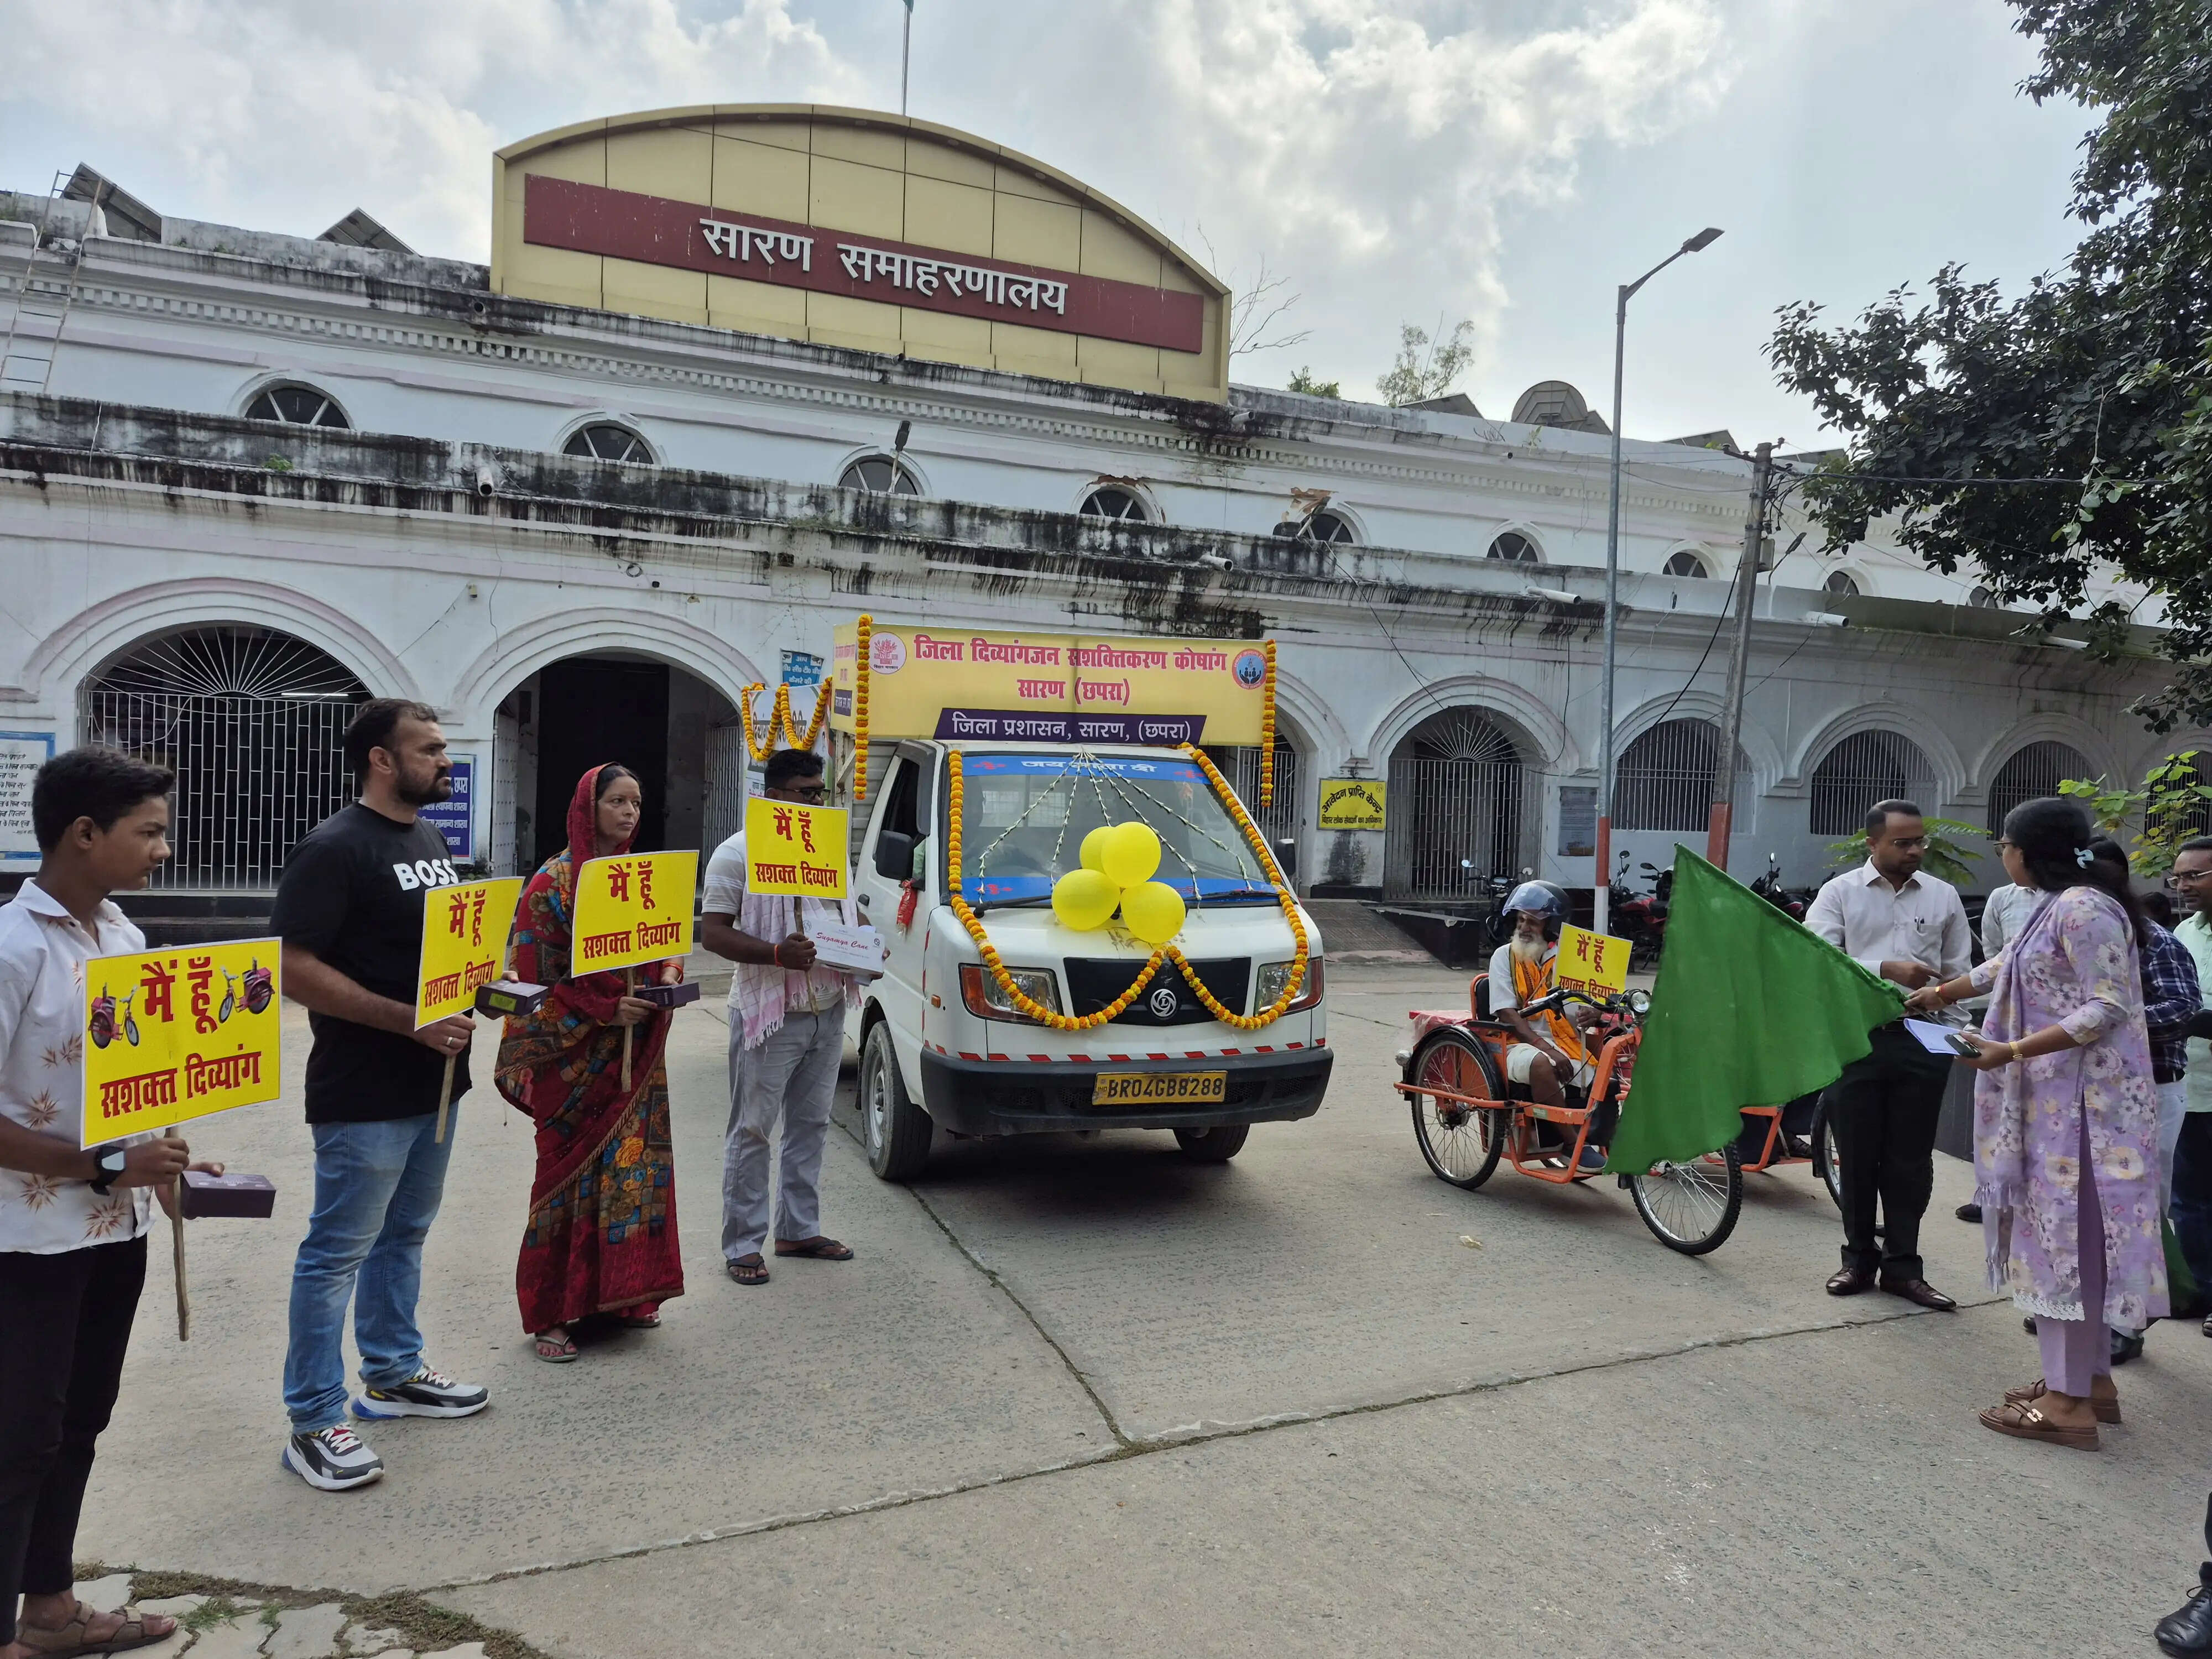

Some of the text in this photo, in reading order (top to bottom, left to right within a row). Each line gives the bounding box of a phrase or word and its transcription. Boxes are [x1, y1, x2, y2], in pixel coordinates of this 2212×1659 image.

[700, 218, 1068, 315] सारण समाहरणालय
[914, 634, 964, 660] जिला
[971, 638, 1061, 665] दिव्यांगजन
[1173, 647, 1227, 671] कोषांग
[1017, 677, 1130, 706] सारण (छपरा)
[952, 711, 1191, 742] जिला प्रशासन, सारण, (छपरा)
[1130, 764, 1157, 773] दी
[1322, 789, 1347, 813] आवेदन
[1348, 785, 1366, 799] प्राप्ति
[773, 807, 816, 853] मैं हूँ
[1322, 814, 1332, 824] बिहार
[1365, 815, 1382, 824] अधिकार
[393, 858, 459, 891] BOSS
[608, 860, 656, 910] मैं हूँ
[755, 861, 838, 888] सशक्त दिव्यांग
[449, 889, 486, 947] मैं हूँ
[583, 916, 681, 959] सशक्त दिव्यांग
[816, 932, 848, 945] Sugamya
[851, 941, 868, 950] Cane
[1577, 933, 1604, 973] मैं हूँ
[140, 956, 218, 1034] मैं हूँ
[425, 972, 461, 1008] सशक्त
[464, 954, 495, 995] दिव्यांग
[100, 1044, 262, 1118] सशक्त दिव्यांग
[1107, 1078, 1223, 1098] BR04GB8288
